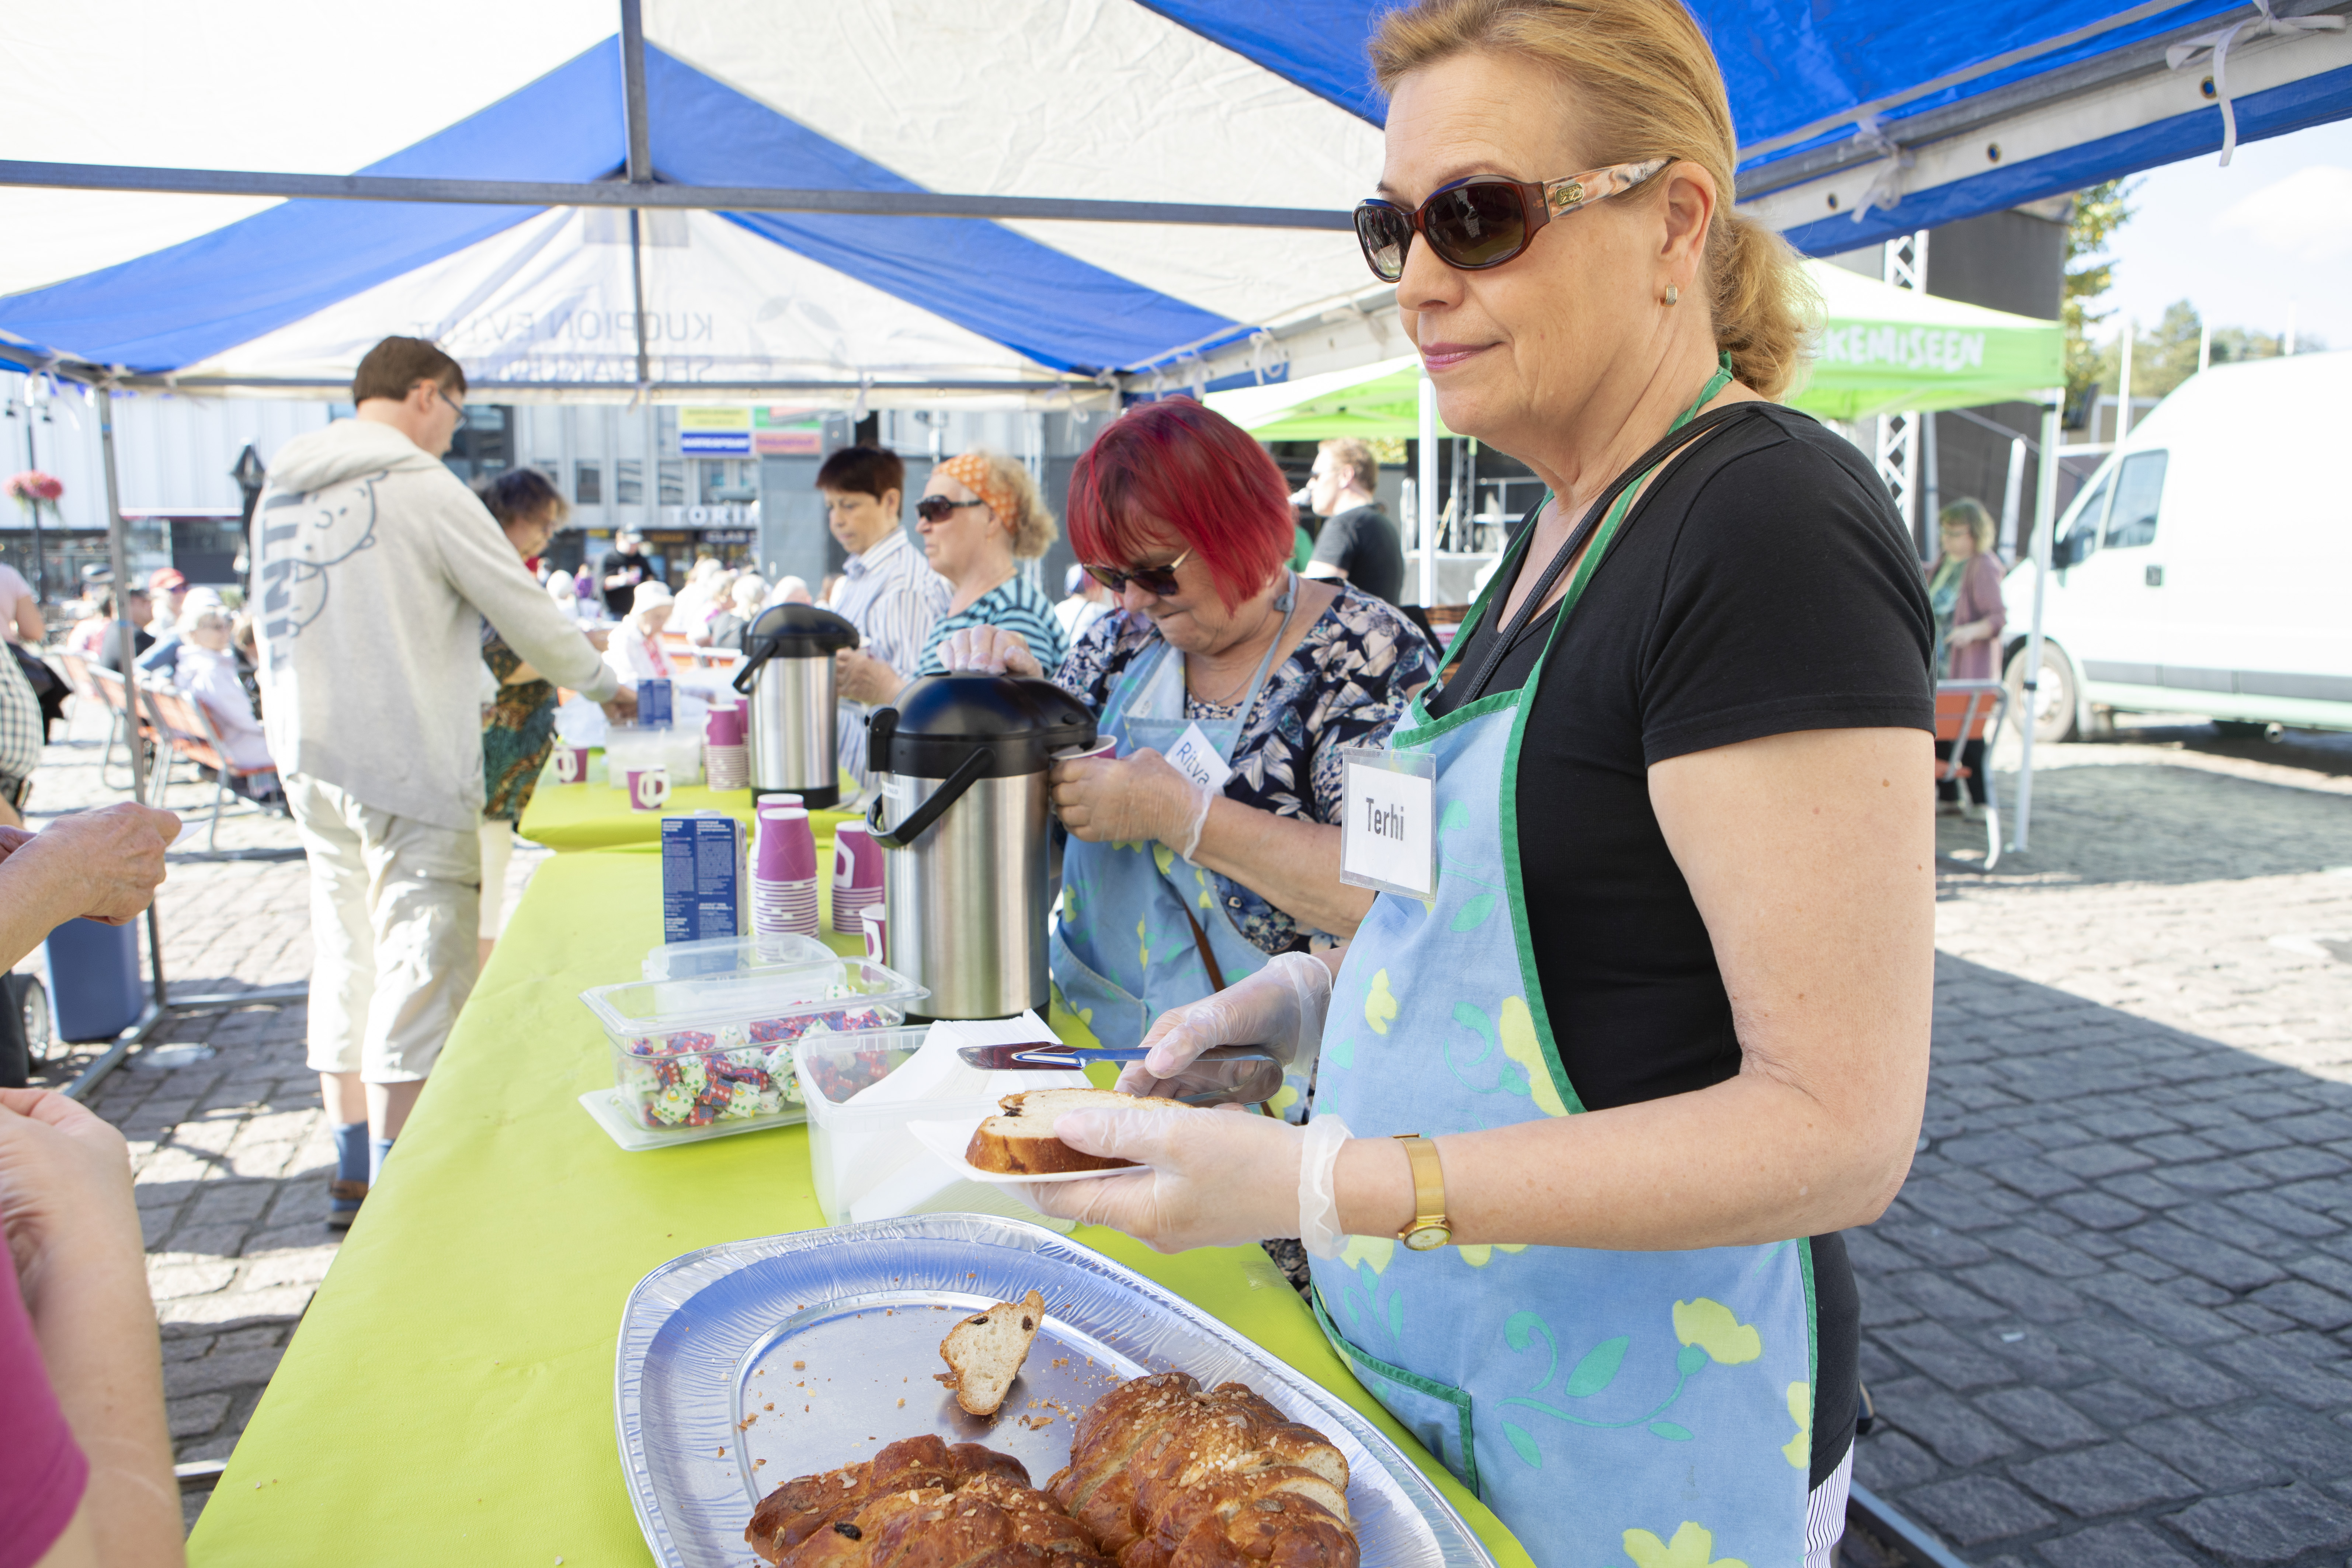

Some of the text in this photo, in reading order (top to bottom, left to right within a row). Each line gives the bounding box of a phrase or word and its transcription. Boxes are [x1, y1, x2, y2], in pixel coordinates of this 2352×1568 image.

[1560, 185, 1580, 196] GUESS
[1825, 325, 1986, 372] KEMISEEN
[1176, 741, 1210, 785] Ritva
[1366, 797, 1404, 841] Terhi
